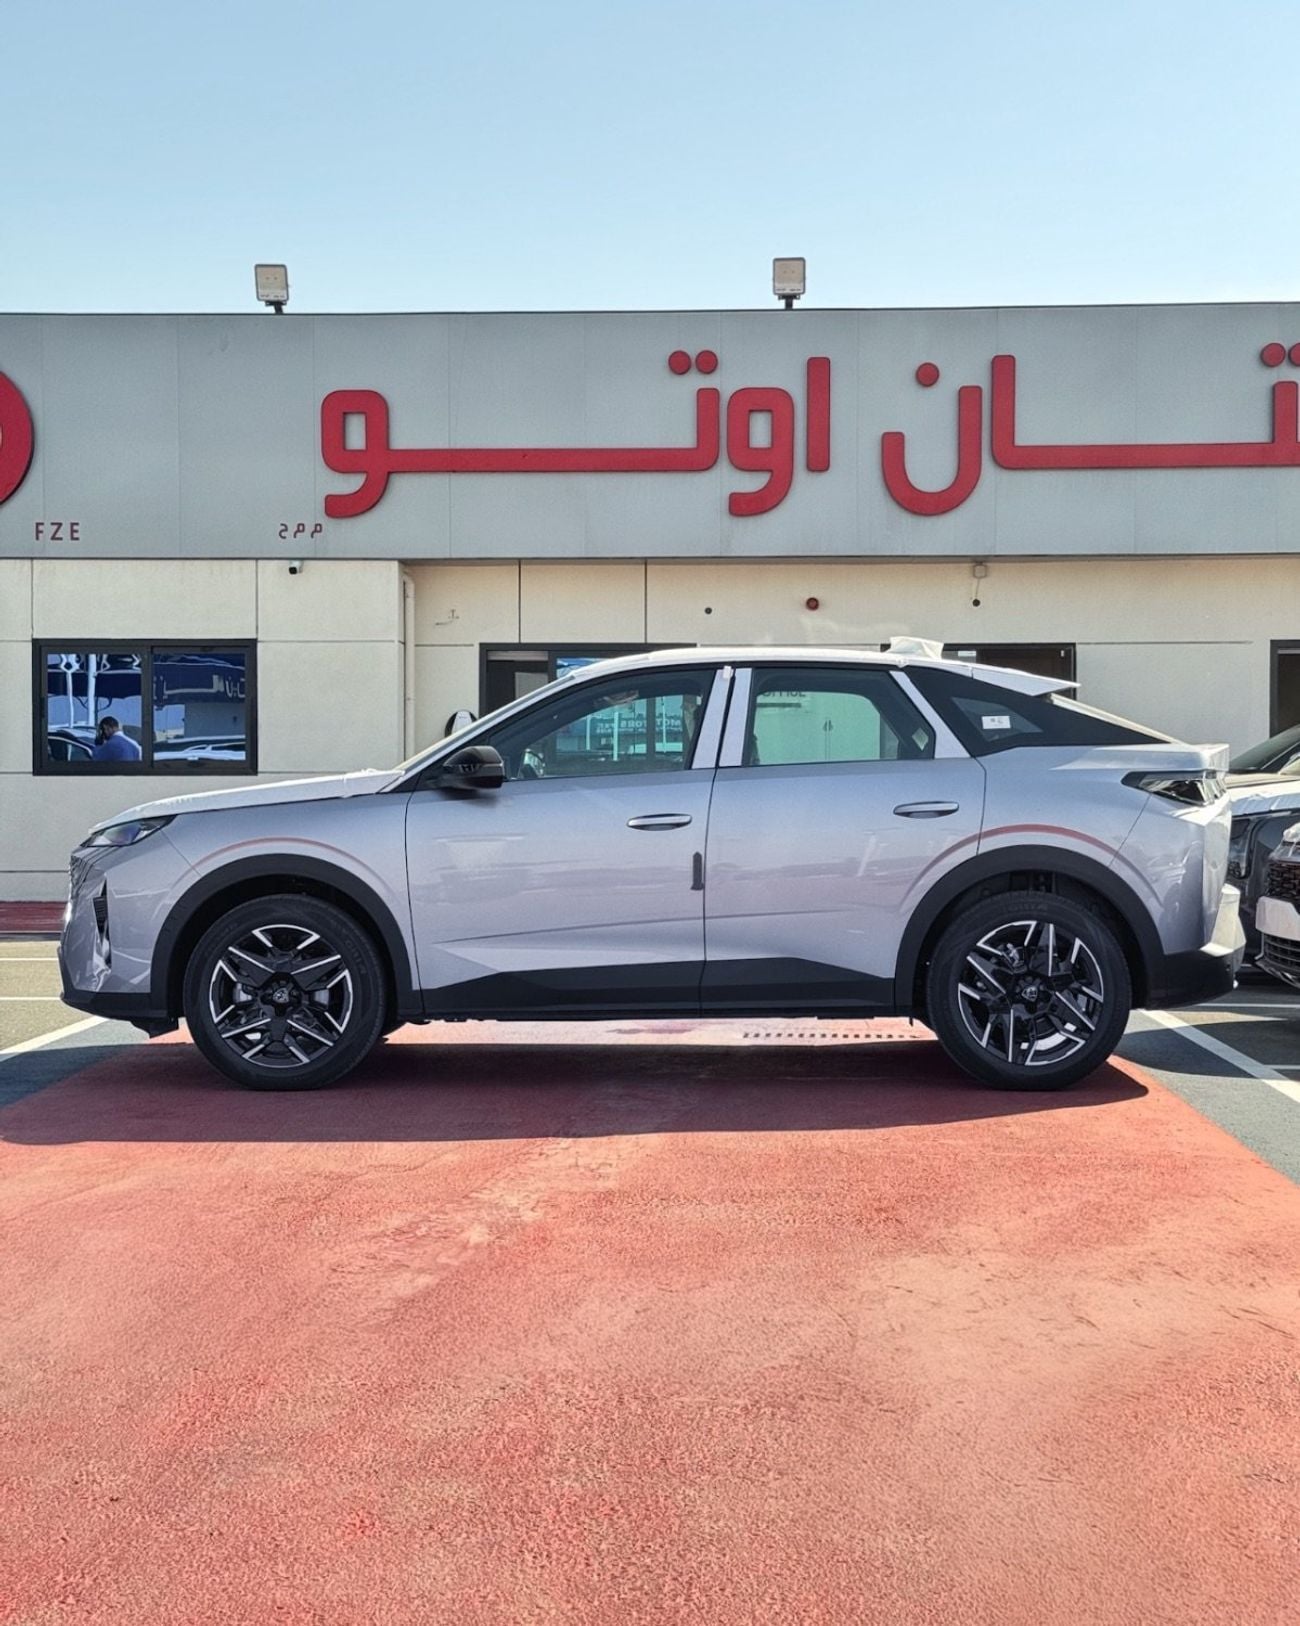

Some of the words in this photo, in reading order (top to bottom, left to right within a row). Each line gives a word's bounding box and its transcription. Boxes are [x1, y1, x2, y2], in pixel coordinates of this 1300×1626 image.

[321, 349, 832, 519] اوتو
[881, 342, 1300, 516] تان
[35, 521, 80, 541] FZE
